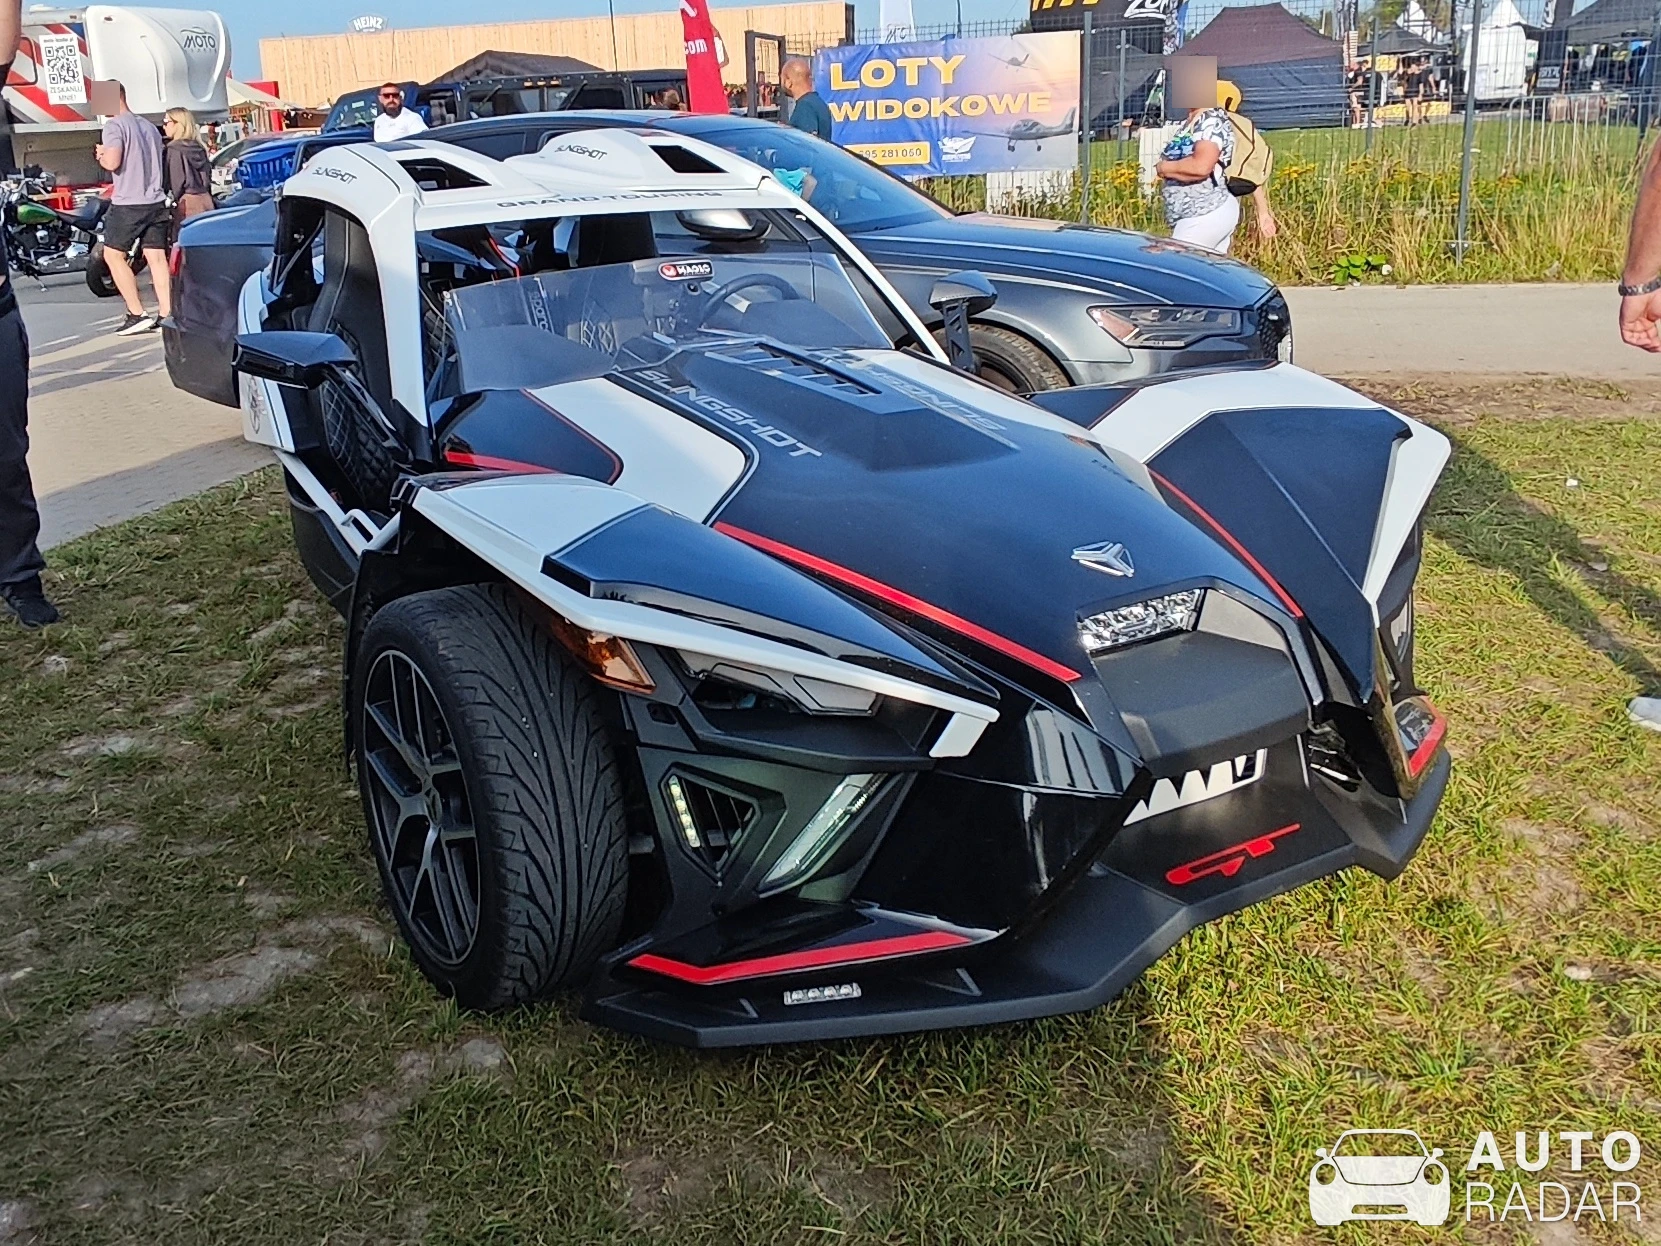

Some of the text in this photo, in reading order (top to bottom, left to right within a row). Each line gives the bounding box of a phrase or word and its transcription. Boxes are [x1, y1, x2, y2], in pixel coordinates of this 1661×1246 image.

[353, 16, 383, 31] HEINZ
[183, 35, 216, 48] MOTO
[830, 54, 967, 91] LOTY
[828, 91, 1052, 122] WIDOKOWE
[859, 149, 878, 159] 95
[881, 148, 899, 158] 281
[497, 191, 723, 208] GRAND TOURING
[634, 370, 822, 457] SLINGSHOT
